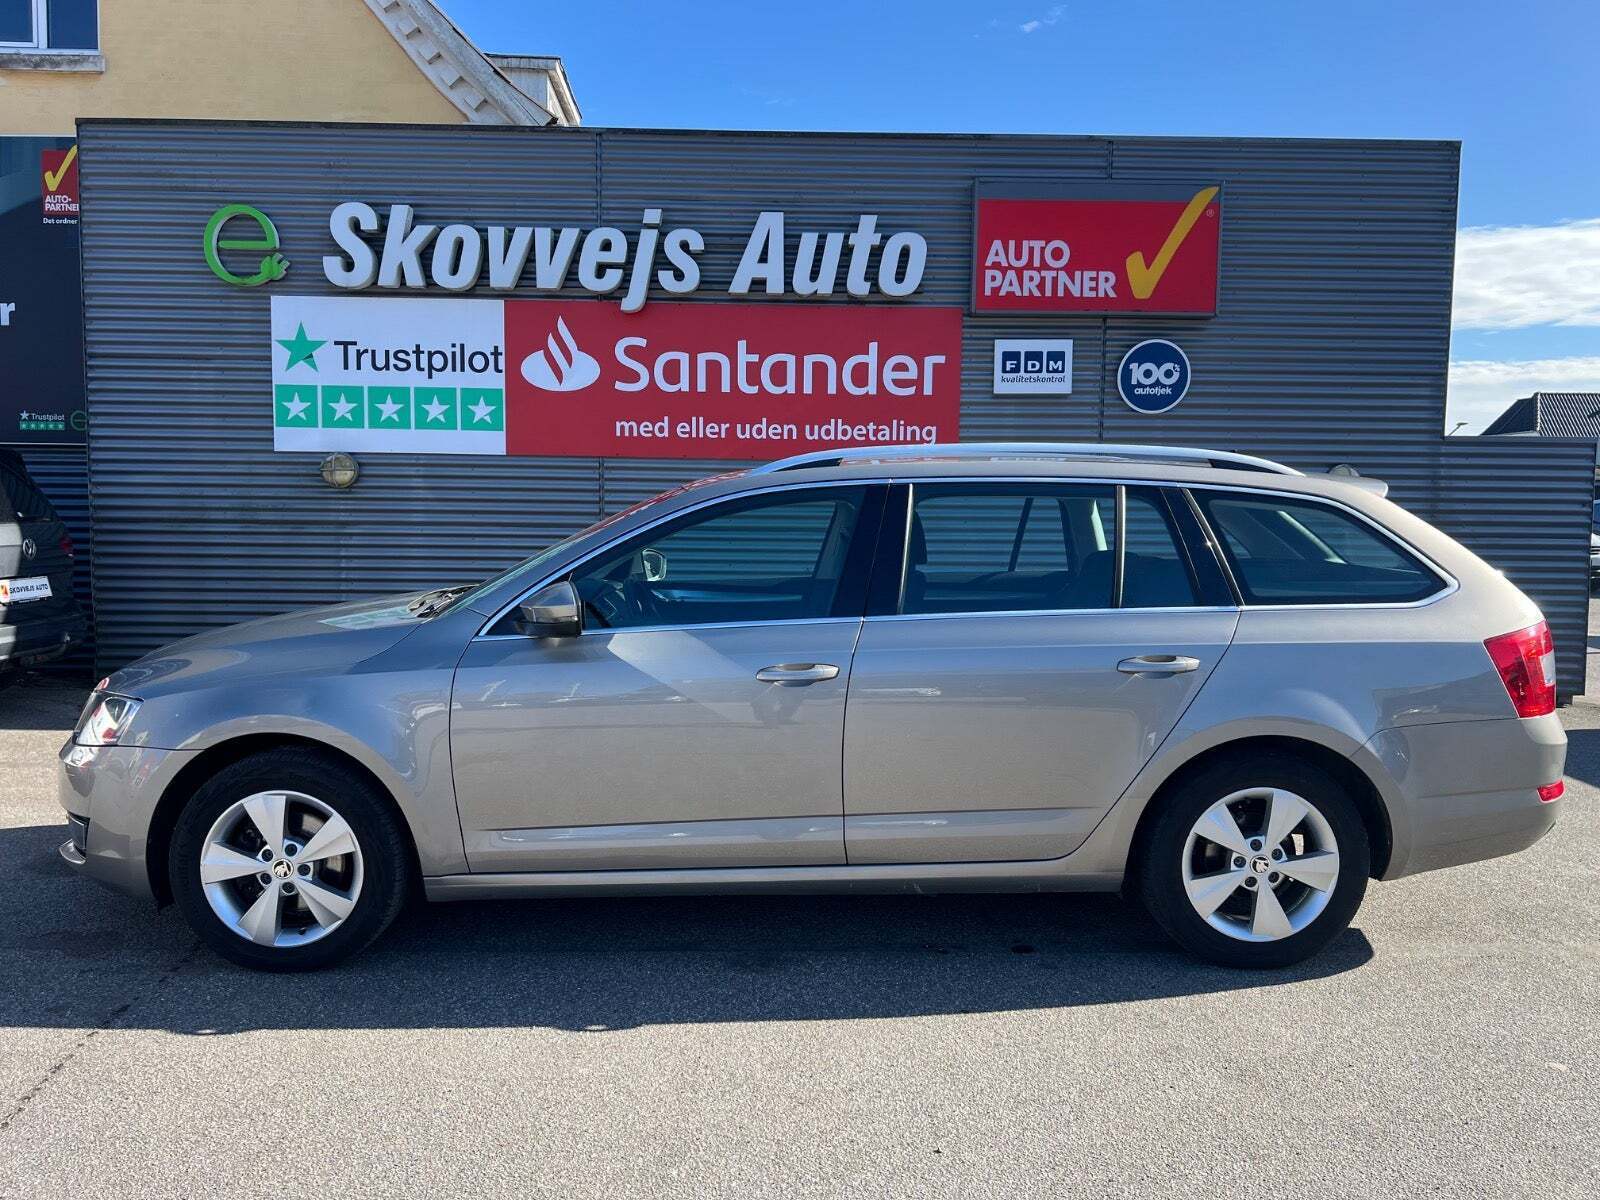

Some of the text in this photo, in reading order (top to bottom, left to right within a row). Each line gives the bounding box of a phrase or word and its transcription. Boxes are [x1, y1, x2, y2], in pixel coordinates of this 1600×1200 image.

[55, 217, 78, 225] ordner
[322, 201, 929, 312] Skovvejs Auto
[984, 239, 1071, 269] AUTO
[984, 269, 1118, 298] PARTNER
[333, 340, 504, 379] Trustpilot
[614, 336, 947, 397] Santander
[1004, 359, 1064, 372] FDM
[1001, 374, 1066, 384] kvalitetskontrol
[1134, 385, 1172, 396] autotjek
[31, 413, 65, 422] Trustpilot
[614, 415, 938, 445] med eller uden udbetaling
[35, 583, 49, 591] AUTO
